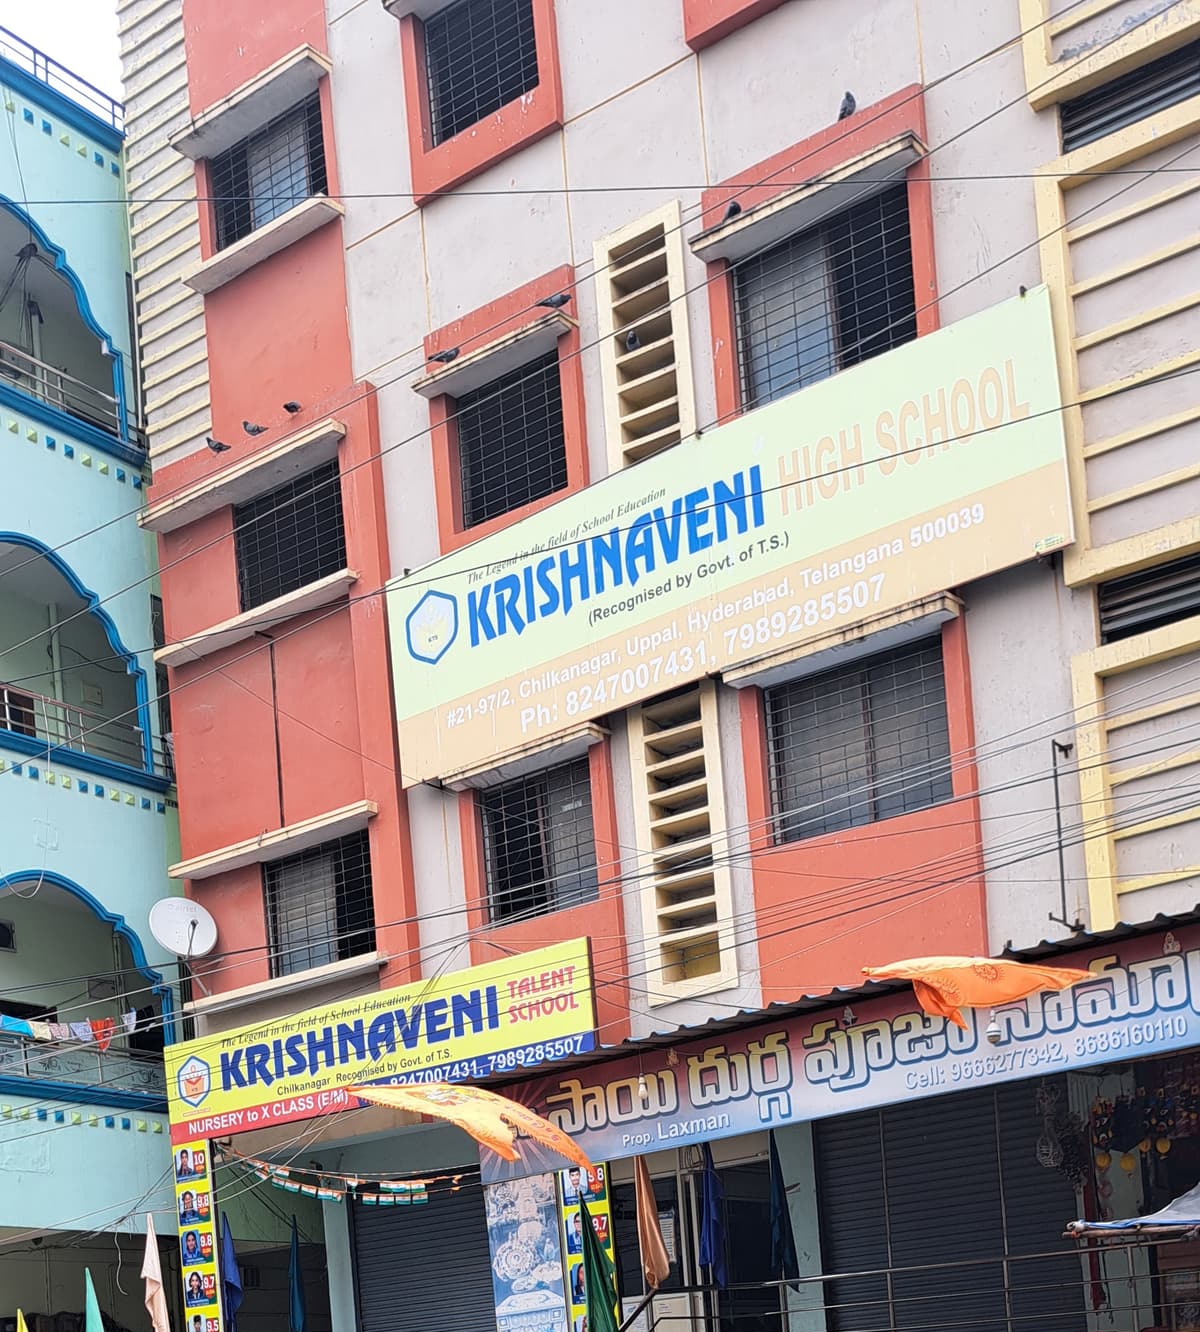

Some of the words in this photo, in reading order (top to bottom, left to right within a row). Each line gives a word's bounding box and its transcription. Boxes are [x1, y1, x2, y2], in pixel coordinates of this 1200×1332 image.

[467, 464, 765, 648] KRISHNAVENI
[778, 423, 865, 516] HIGH
[875, 358, 1030, 476] SCHOOL
[467, 572, 484, 584] The
[486, 554, 518, 577] Legend
[519, 550, 529, 562] in
[531, 543, 546, 557] the
[547, 530, 569, 552] field
[570, 525, 581, 540] of
[582, 511, 615, 534] School
[617, 488, 666, 518] Education
[519, 647, 622, 699] Chilkanagar,
[626, 619, 683, 657] Uppal,
[686, 577, 795, 632] Hyderabad,
[800, 536, 904, 589] Telangana
[909, 502, 985, 548] 500039
[588, 579, 672, 627] (Recognised
[676, 569, 692, 589] by
[696, 555, 735, 579] Govt.
[739, 544, 754, 562] of
[757, 531, 790, 556] T.S.)
[520, 701, 560, 734] Ph:
[565, 639, 718, 717] 8247007431,
[723, 571, 886, 656] 7989285507
[506, 965, 576, 999] TALENT
[508, 991, 579, 1024] SCHOOL
[219, 984, 500, 1092] KRISHNAVENI
[221, 1037, 236, 1049] The
[237, 1028, 268, 1045] Legend
[270, 1026, 280, 1036] in
[281, 1020, 296, 1033] the
[296, 1014, 317, 1034] field
[318, 1012, 330, 1026] of
[331, 1005, 361, 1021] School
[363, 994, 411, 1013] Education
[277, 1076, 331, 1096] Chilkanagar
[336, 1065, 385, 1083] Recognised
[387, 1062, 398, 1075] by
[400, 1055, 424, 1068] Govt.
[427, 1053, 436, 1062] of
[437, 1049, 453, 1060] T.S.
[487, 1036, 584, 1072] 7989285507
[905, 1065, 945, 1090] Cell:
[951, 1041, 1069, 1082] 9666277342,
[1074, 1015, 1187, 1056] 8686160110
[188, 1112, 244, 1136] NURSERY
[247, 1110, 259, 1121] to
[262, 1106, 270, 1119] X
[272, 1097, 314, 1116] CLASS
[317, 1089, 349, 1110] (E/M)
[622, 1131, 654, 1147] Prop.
[657, 1112, 731, 1140] Laxman
[592, 1215, 608, 1231] 9.7
[207, 1319, 219, 1332] 9.5
